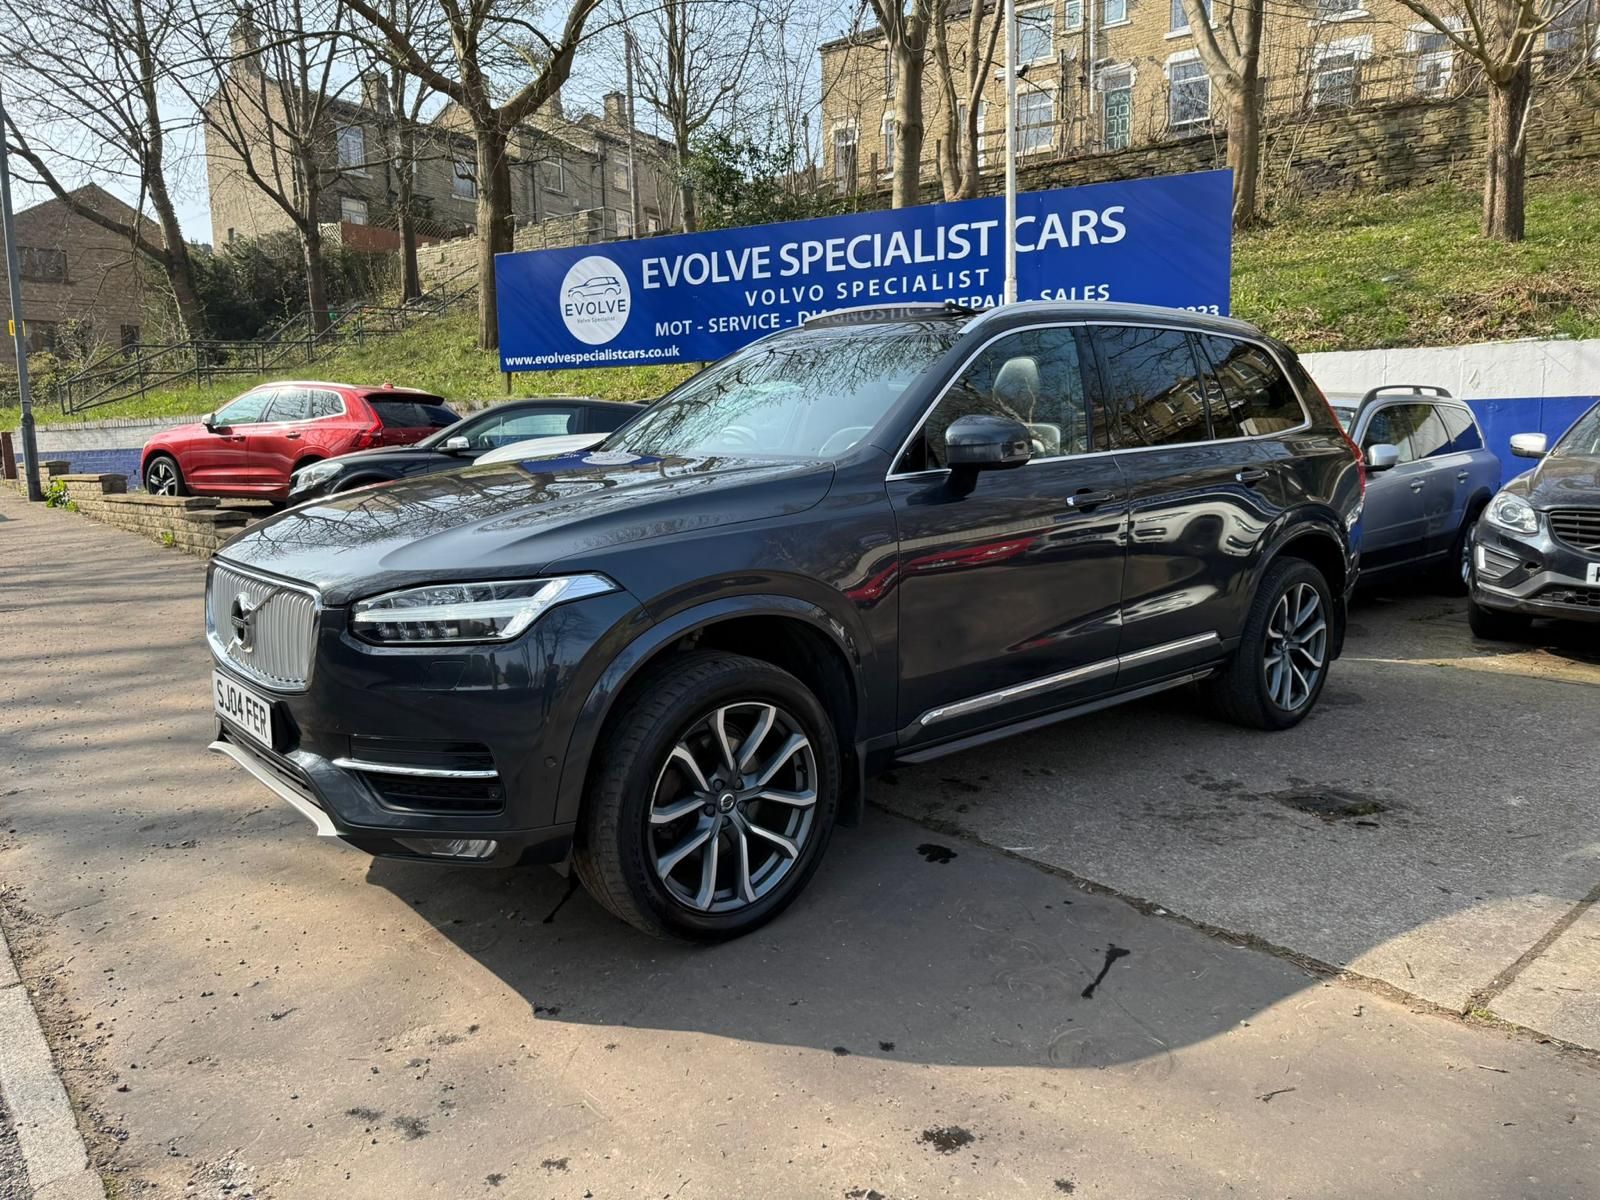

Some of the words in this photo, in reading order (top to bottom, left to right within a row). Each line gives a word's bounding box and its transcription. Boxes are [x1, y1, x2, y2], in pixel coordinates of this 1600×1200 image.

[642, 246, 771, 289] EVOLVE
[780, 220, 998, 277] SPECIALIST
[1014, 206, 1126, 252] CARS
[745, 284, 824, 306] VOLVO
[837, 268, 989, 299] SPECIALIST
[565, 299, 627, 317] EVOLVE
[655, 320, 693, 337] MOT
[708, 313, 780, 333] SERVICE
[505, 345, 680, 366] www.evolvespecialistcars.co.uk
[216, 679, 244, 721] SJ04
[245, 696, 268, 739] FER
